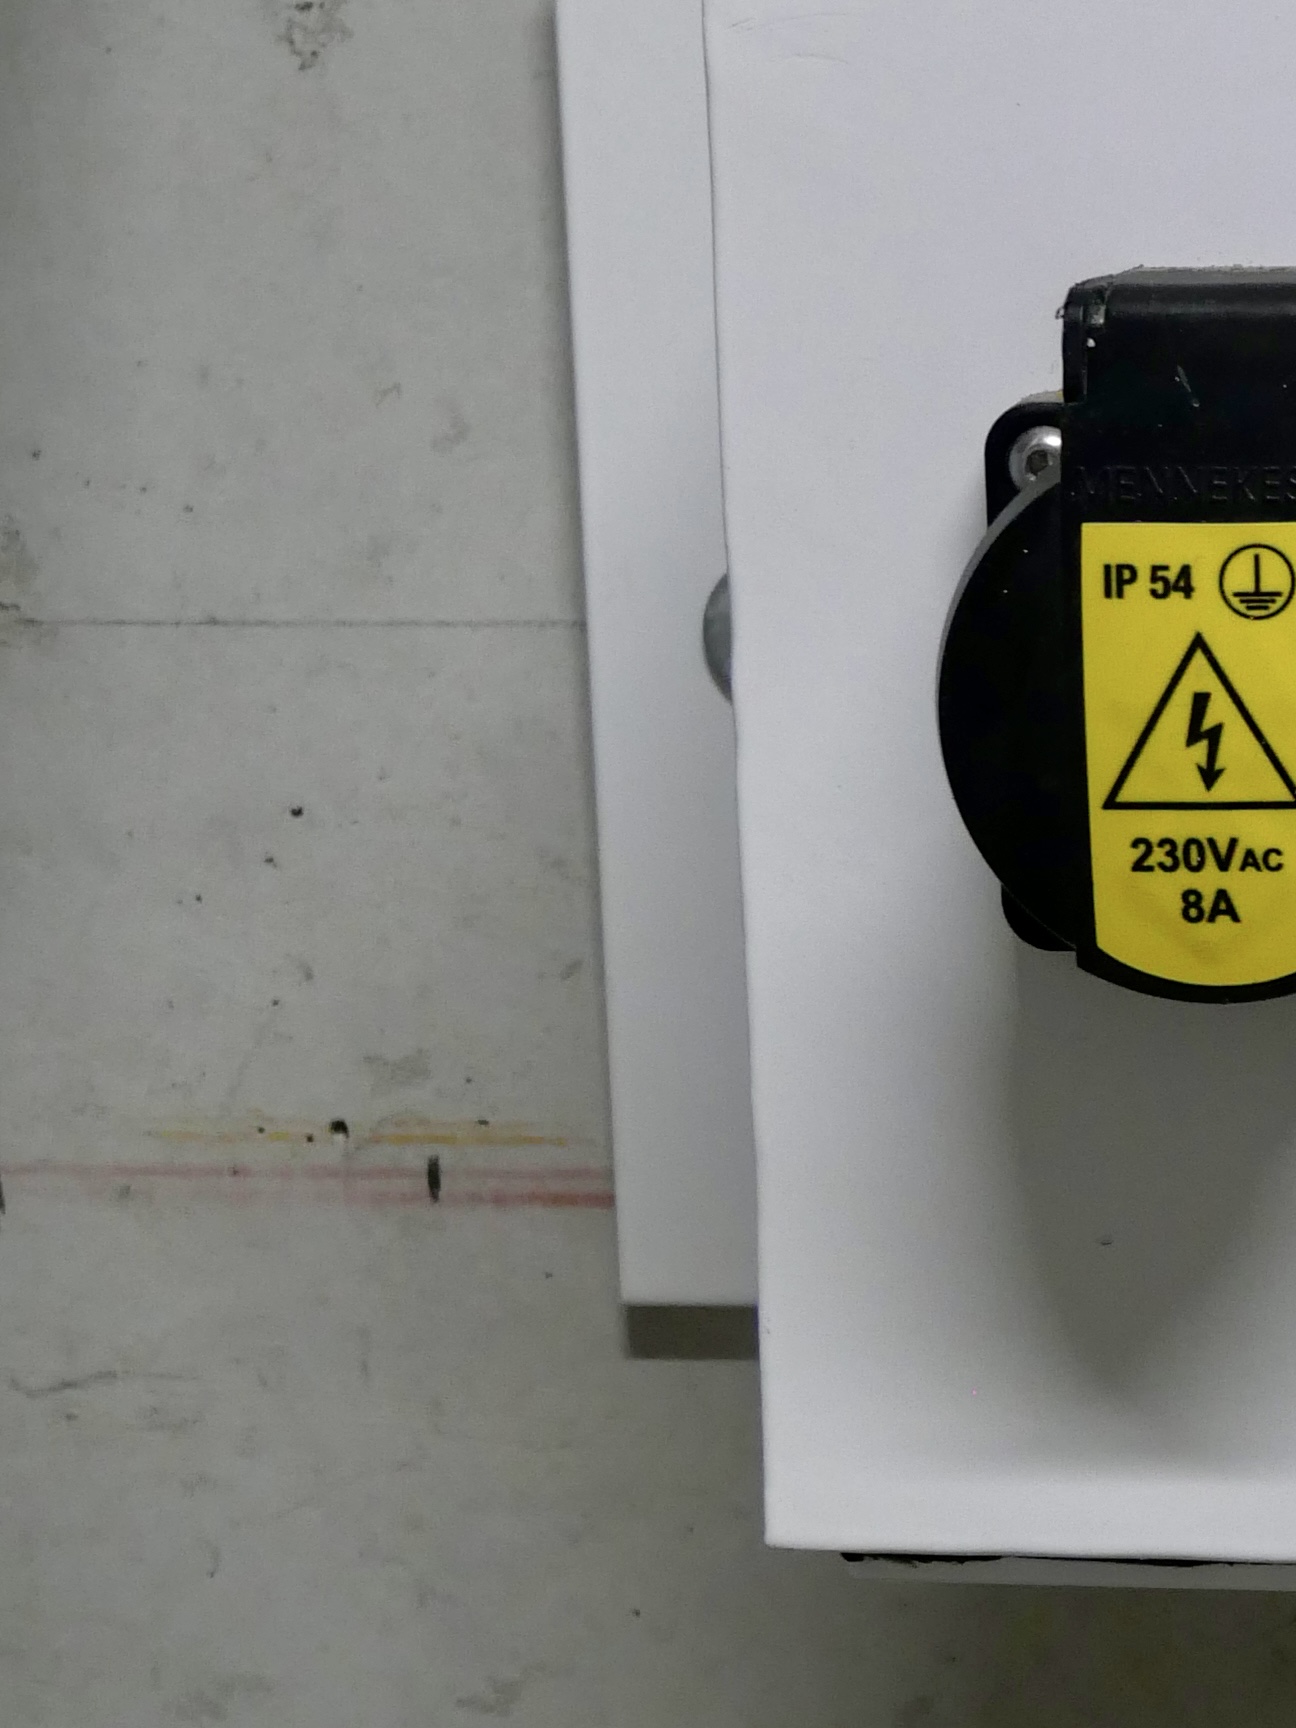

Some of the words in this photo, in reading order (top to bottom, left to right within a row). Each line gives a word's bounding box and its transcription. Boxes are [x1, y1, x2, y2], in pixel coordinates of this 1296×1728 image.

[1103, 563, 1139, 600] IP
[1148, 563, 1196, 600] 54
[1130, 836, 1284, 874] 230VAC
[1180, 887, 1242, 925] 8A
